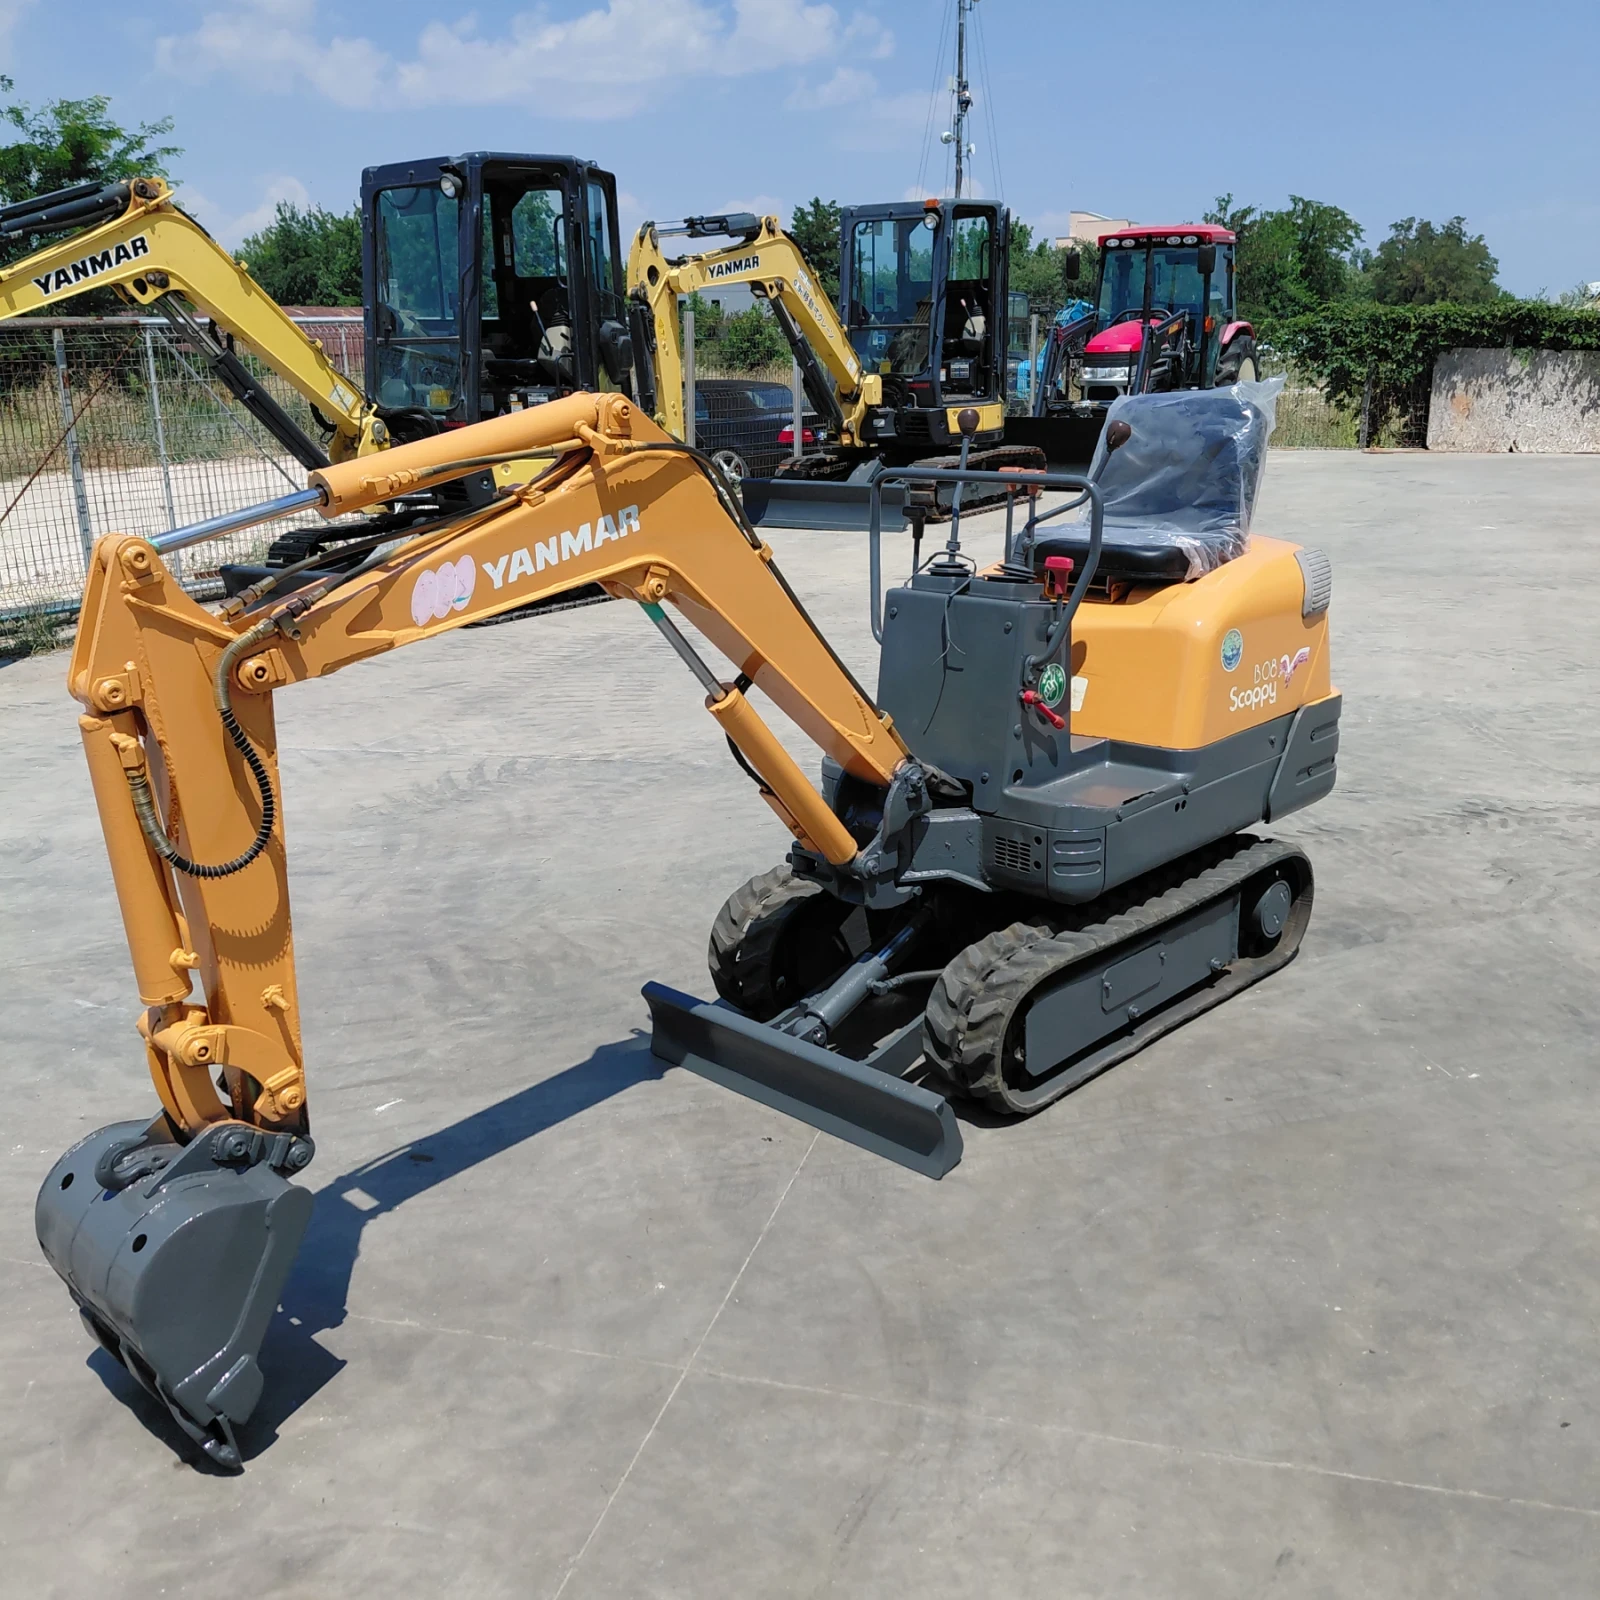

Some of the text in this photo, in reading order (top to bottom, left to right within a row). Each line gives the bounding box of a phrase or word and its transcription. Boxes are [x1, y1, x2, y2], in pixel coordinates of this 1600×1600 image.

[33, 236, 149, 295] YANMAR
[708, 255, 760, 279] YANMAR
[482, 504, 641, 590] YANMAR
[1229, 681, 1276, 712] Scoppy
